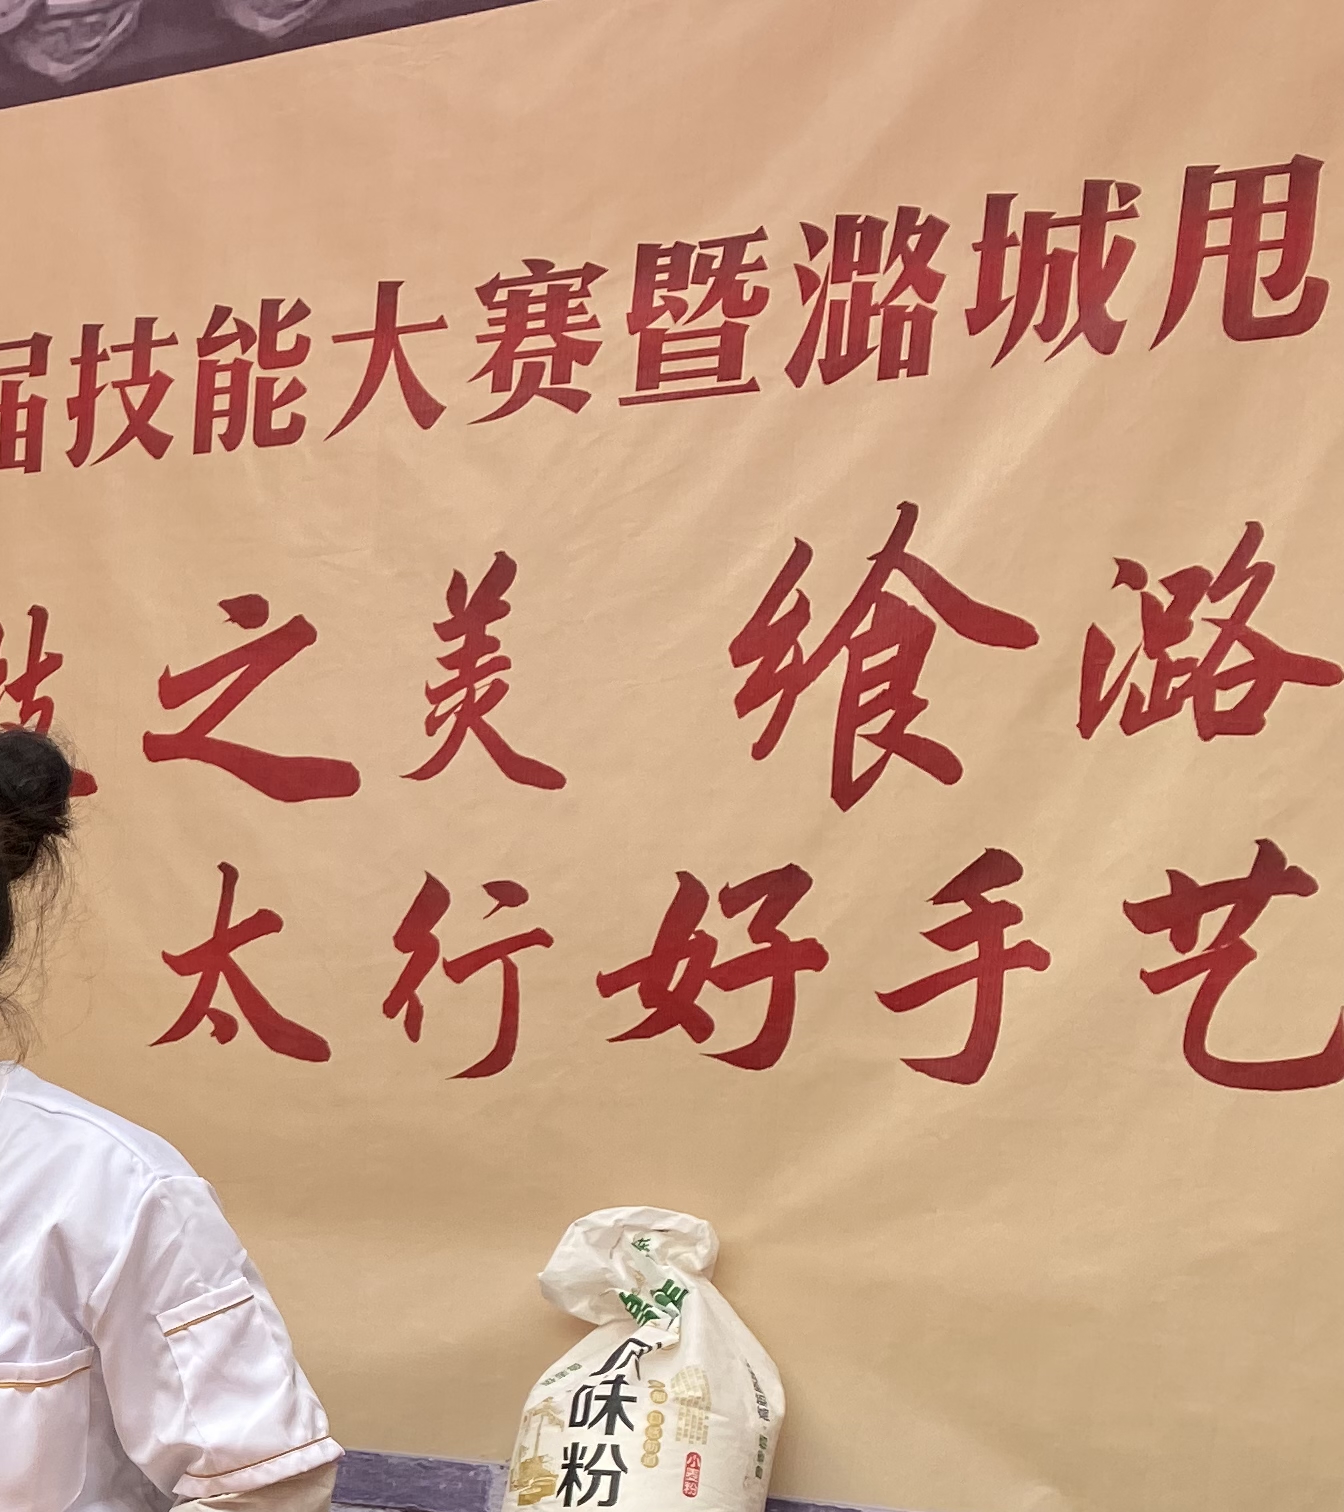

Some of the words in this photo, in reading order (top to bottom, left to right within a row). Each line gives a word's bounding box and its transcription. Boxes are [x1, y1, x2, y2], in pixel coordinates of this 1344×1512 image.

[149, 838, 1344, 1092] 太行好手艺
[683, 1452, 701, 1497] 小麦粉
